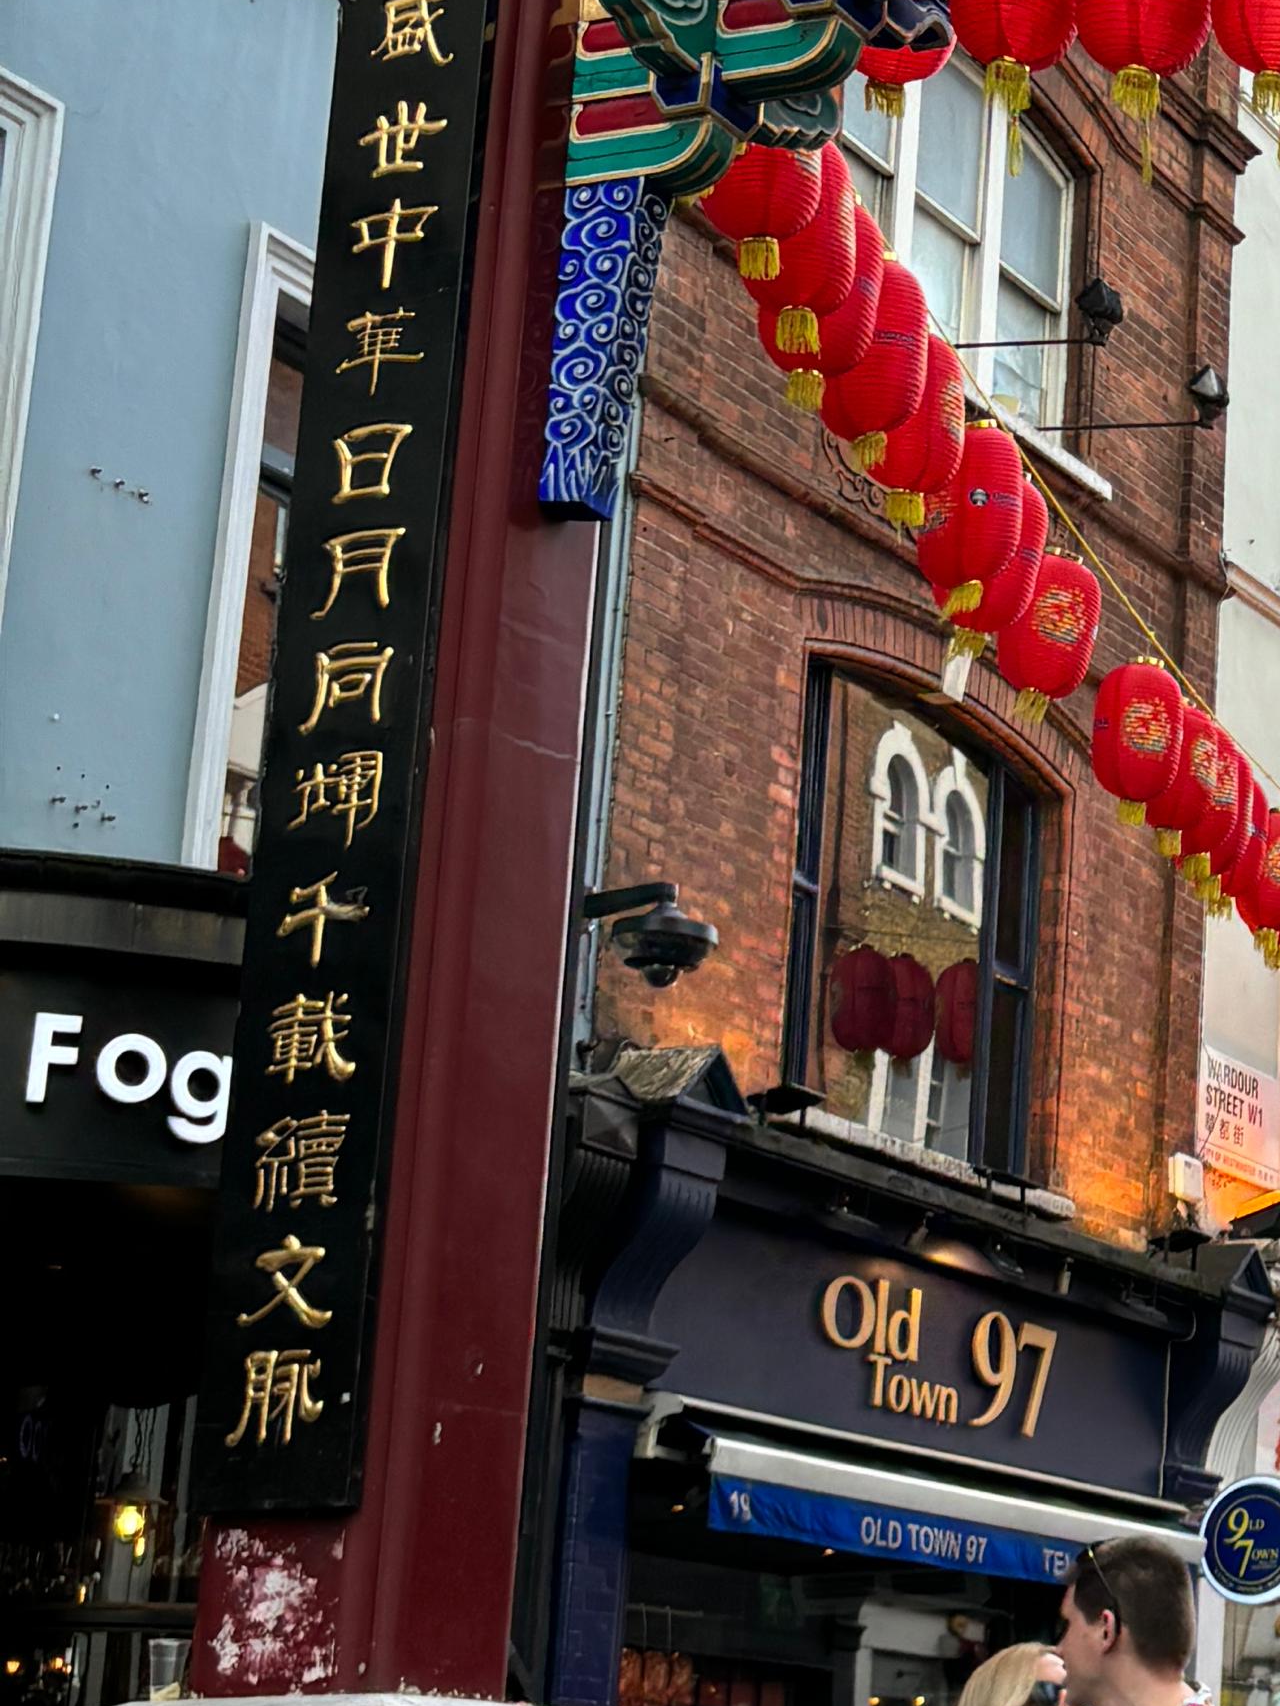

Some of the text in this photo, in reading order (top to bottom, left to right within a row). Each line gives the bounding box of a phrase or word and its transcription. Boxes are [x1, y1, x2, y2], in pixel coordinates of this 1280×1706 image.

[1207, 1057, 1259, 1100] WARDOUR
[1205, 1084, 1263, 1128] STREET W1
[820, 1274, 1057, 1438] Old 97
[868, 1352, 958, 1426] Town
[860, 1515, 988, 1565] OLD TOWN 97
